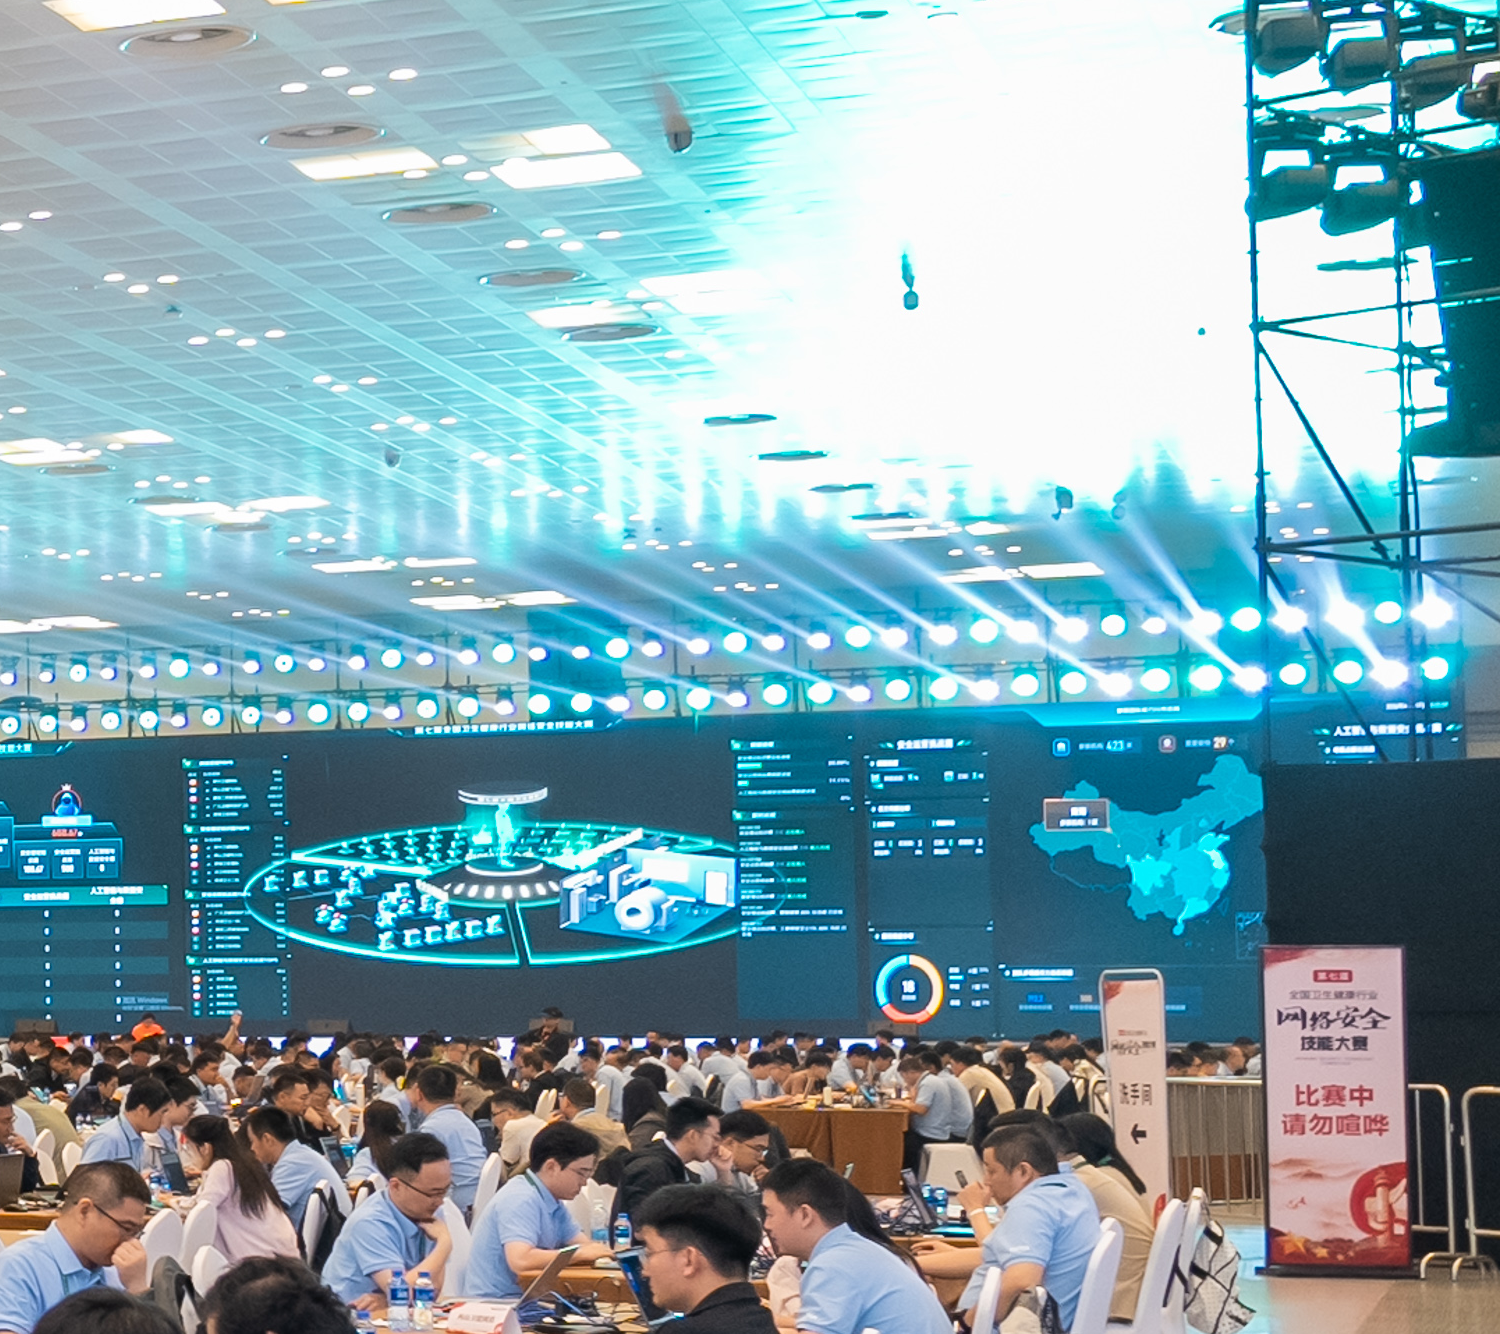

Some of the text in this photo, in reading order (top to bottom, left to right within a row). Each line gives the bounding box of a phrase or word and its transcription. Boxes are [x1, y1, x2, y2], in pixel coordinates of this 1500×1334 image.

[1289, 990, 1378, 1000] 全国卫生健康行业
[1276, 1005, 1391, 1032] 网络安全
[1301, 1036, 1368, 1051] 技能大赛
[1295, 1084, 1374, 1107] 比赛中
[1281, 1113, 1389, 1137] 请勿喧哗
